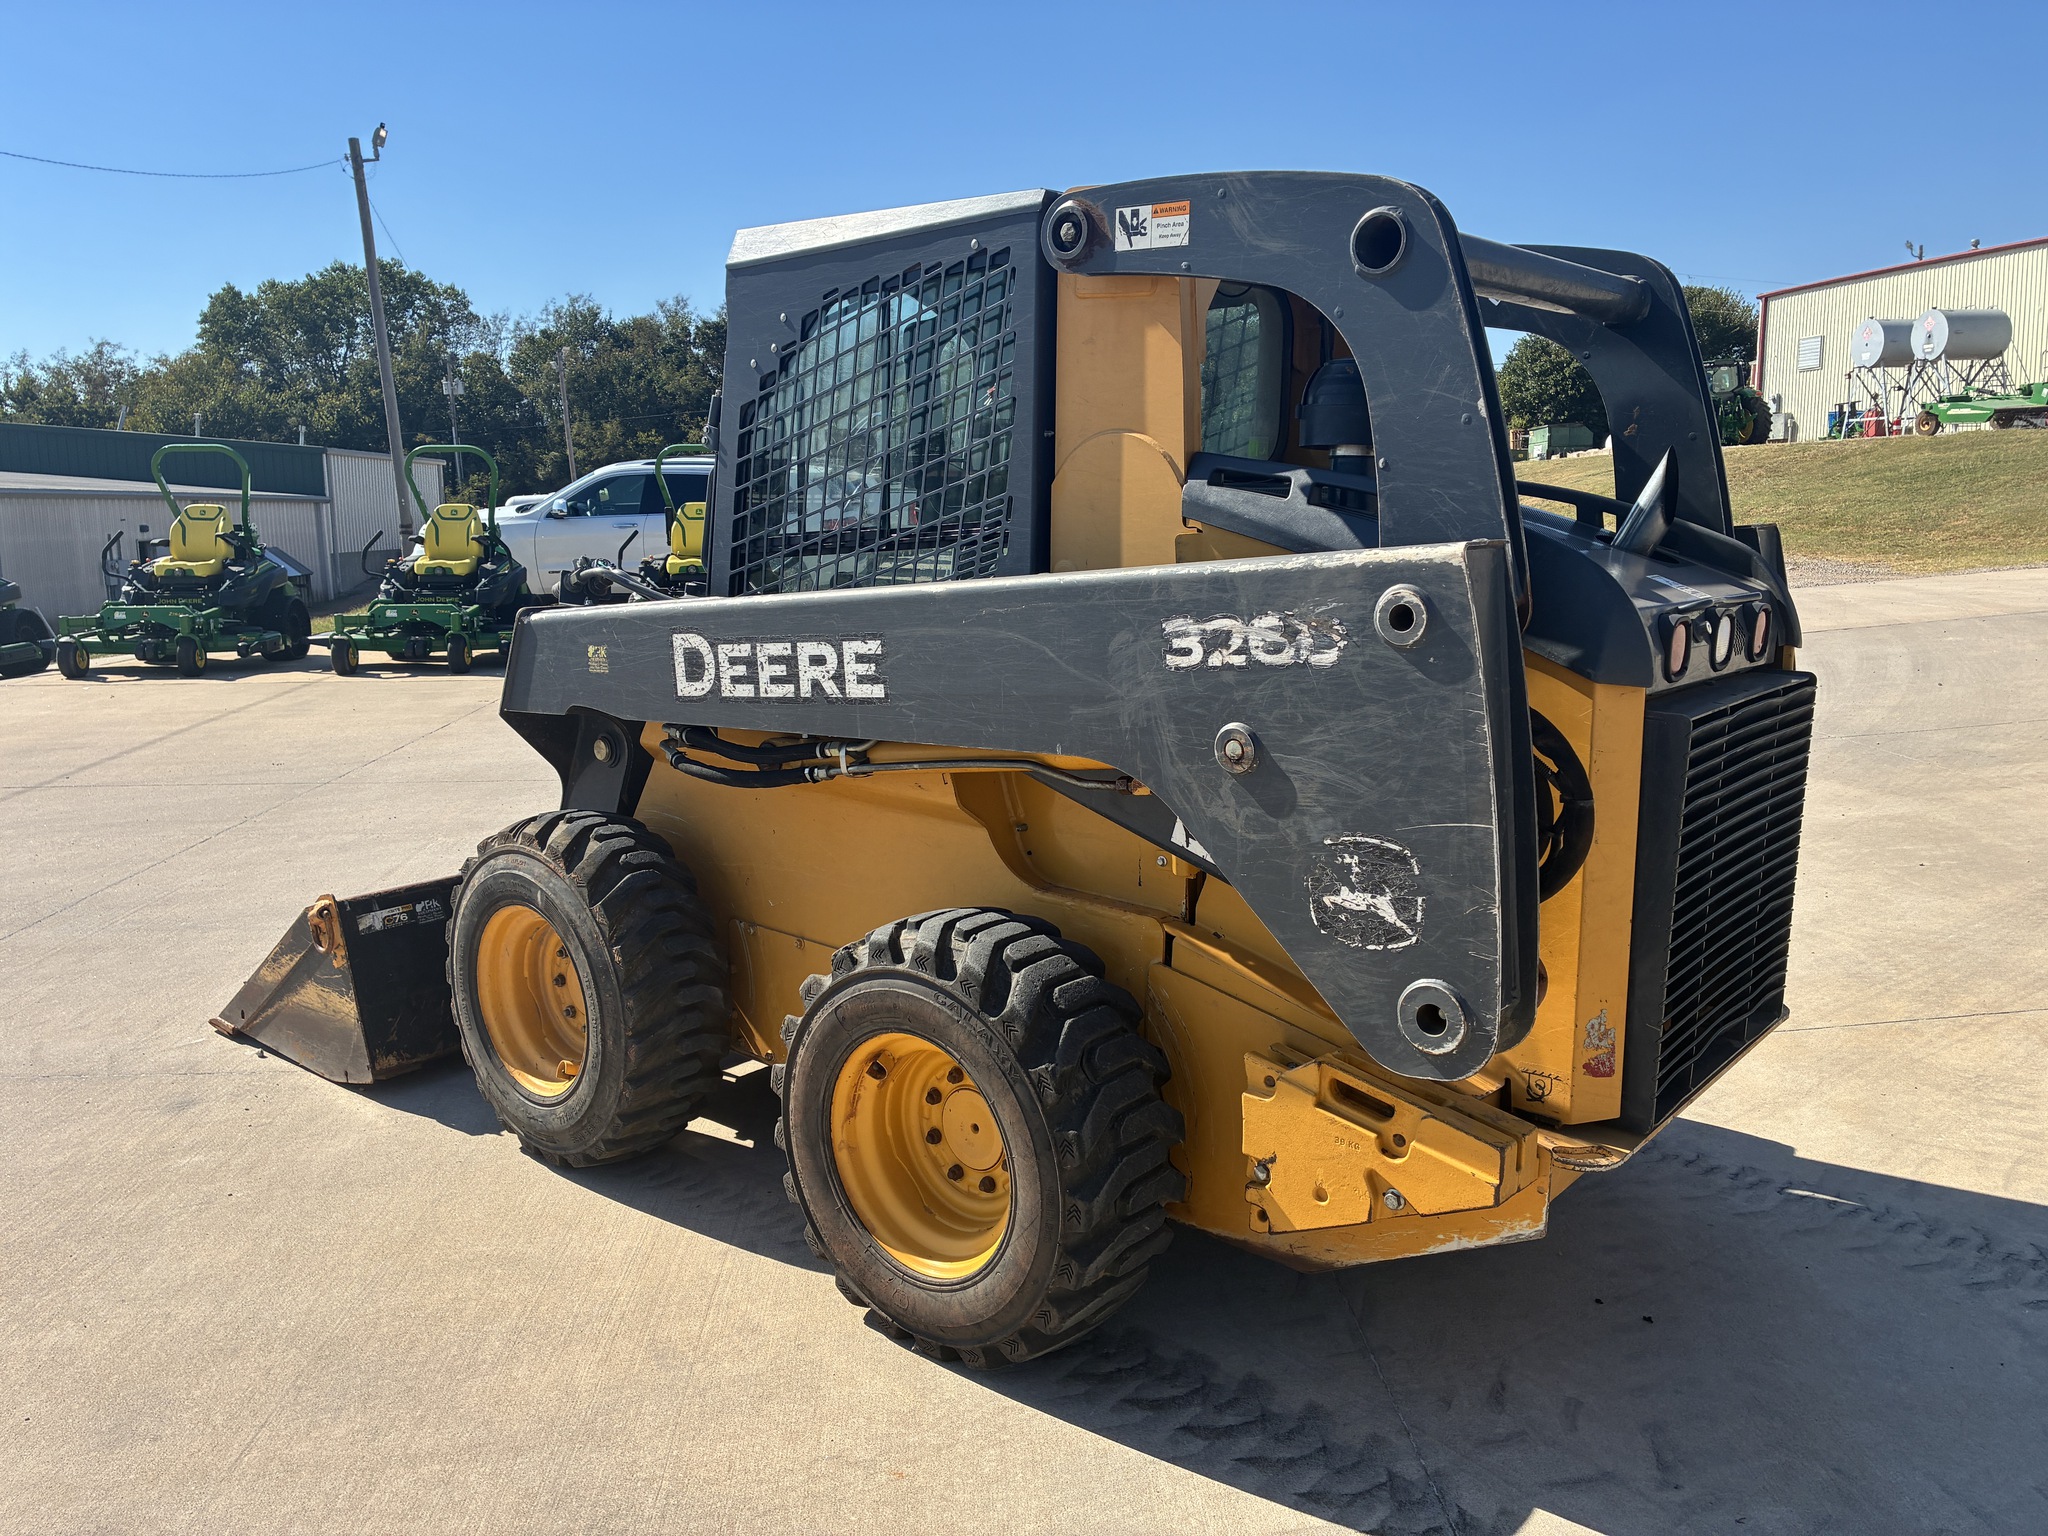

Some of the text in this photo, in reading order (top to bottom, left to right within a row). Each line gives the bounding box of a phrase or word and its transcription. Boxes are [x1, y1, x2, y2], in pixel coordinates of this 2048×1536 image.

[1160, 205, 1187, 214] WARNING
[673, 633, 885, 698] DEERE
[384, 912, 408, 925] C76
[933, 991, 1022, 1080] GALAXY
[1348, 1140, 1361, 1151] KG
